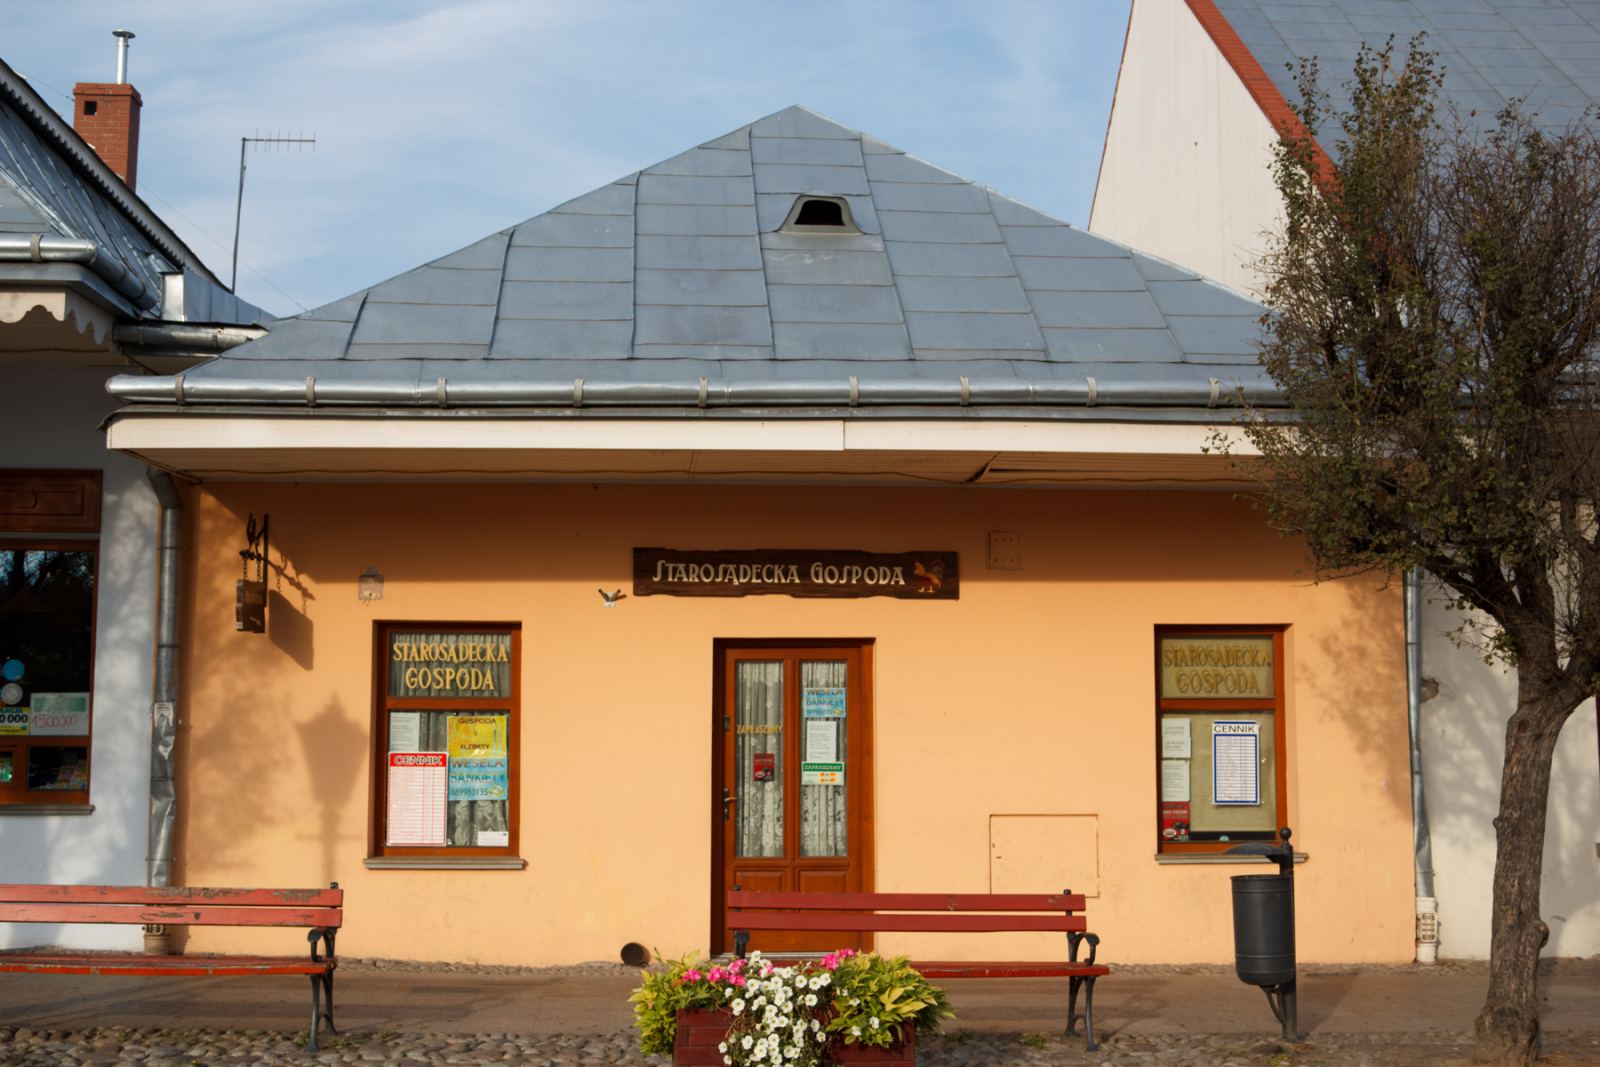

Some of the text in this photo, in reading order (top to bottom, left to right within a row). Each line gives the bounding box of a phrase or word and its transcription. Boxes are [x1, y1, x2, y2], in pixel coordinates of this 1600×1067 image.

[405, 667, 495, 690] GOSPODA
[1175, 669, 1260, 694] GOSPODA
[7, 714, 28, 723] 000
[1213, 725, 1255, 733] CENNIK
[394, 755, 443, 765] CENNIK
[450, 758, 504, 768] WESELA
